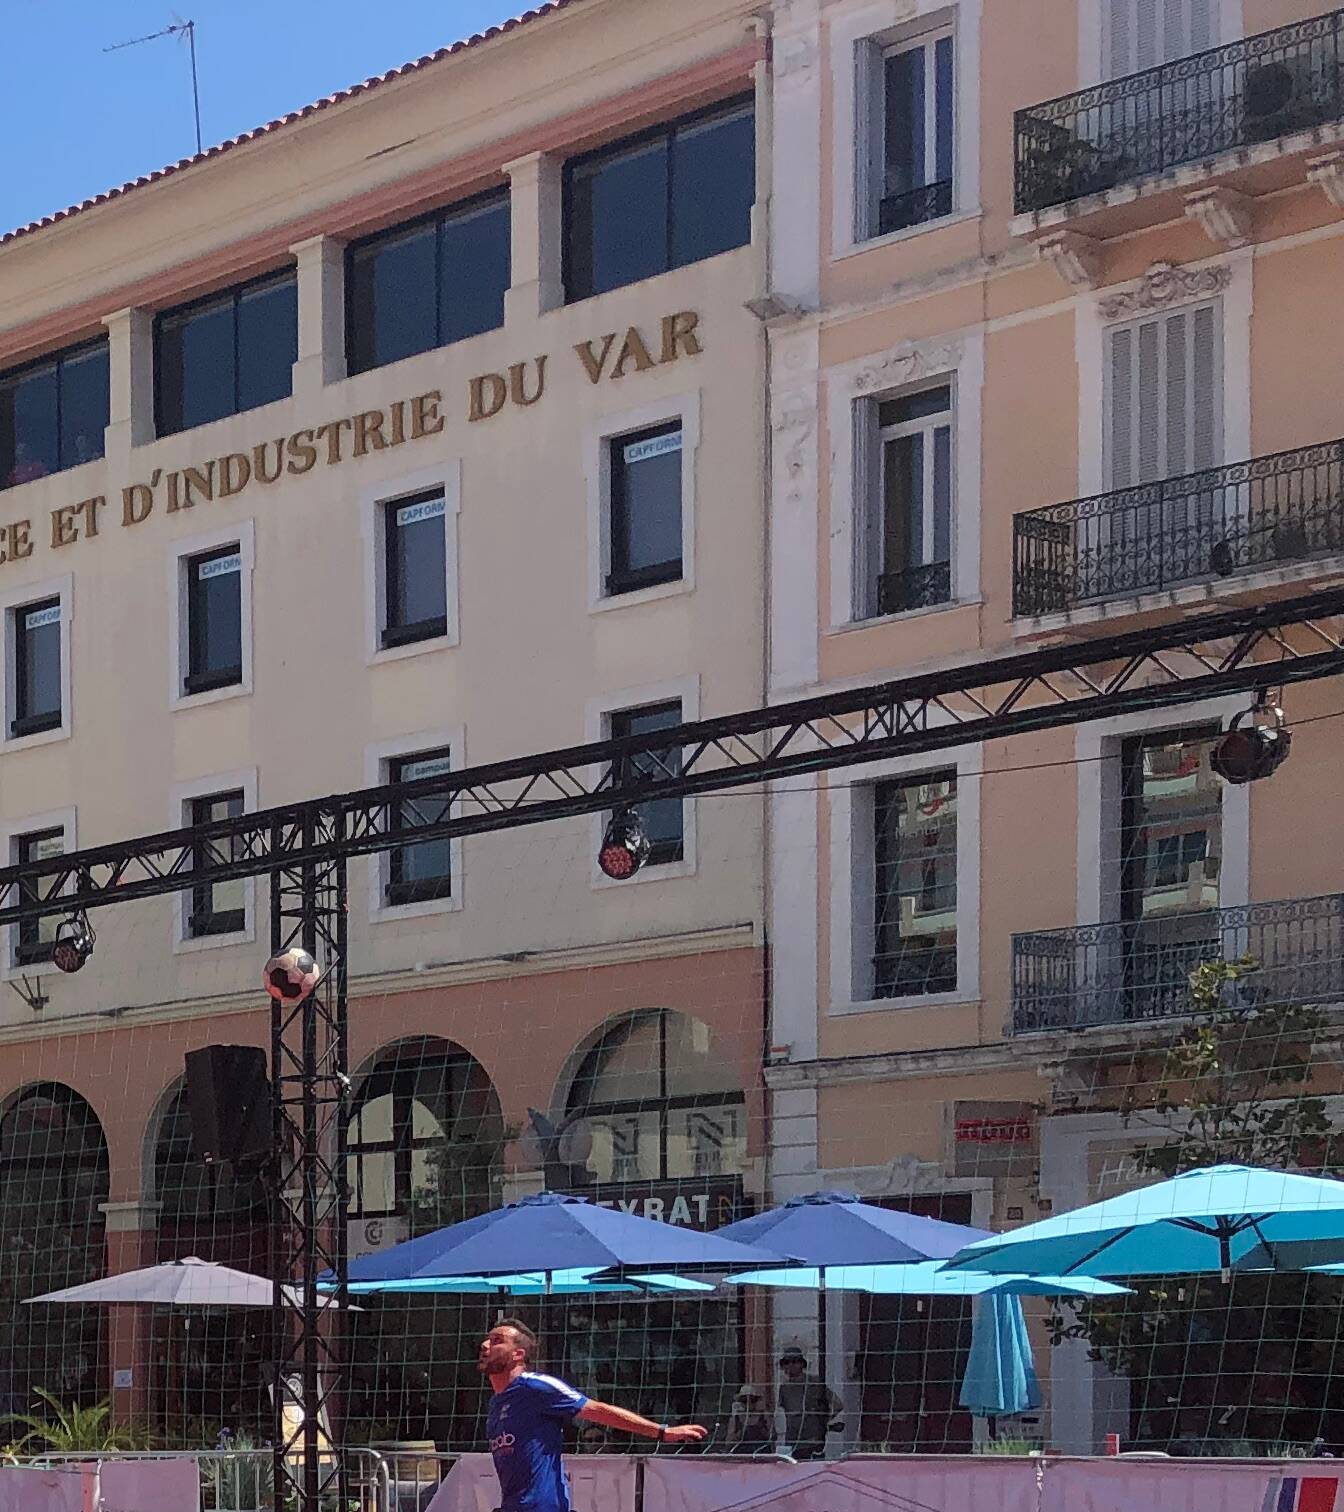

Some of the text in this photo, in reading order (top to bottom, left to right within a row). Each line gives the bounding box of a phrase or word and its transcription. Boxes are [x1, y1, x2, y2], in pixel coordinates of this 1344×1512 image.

[50, 496, 106, 549] ET
[121, 390, 446, 527] D'INDUSTRIE
[468, 355, 548, 423] DU
[573, 311, 704, 385] VAR
